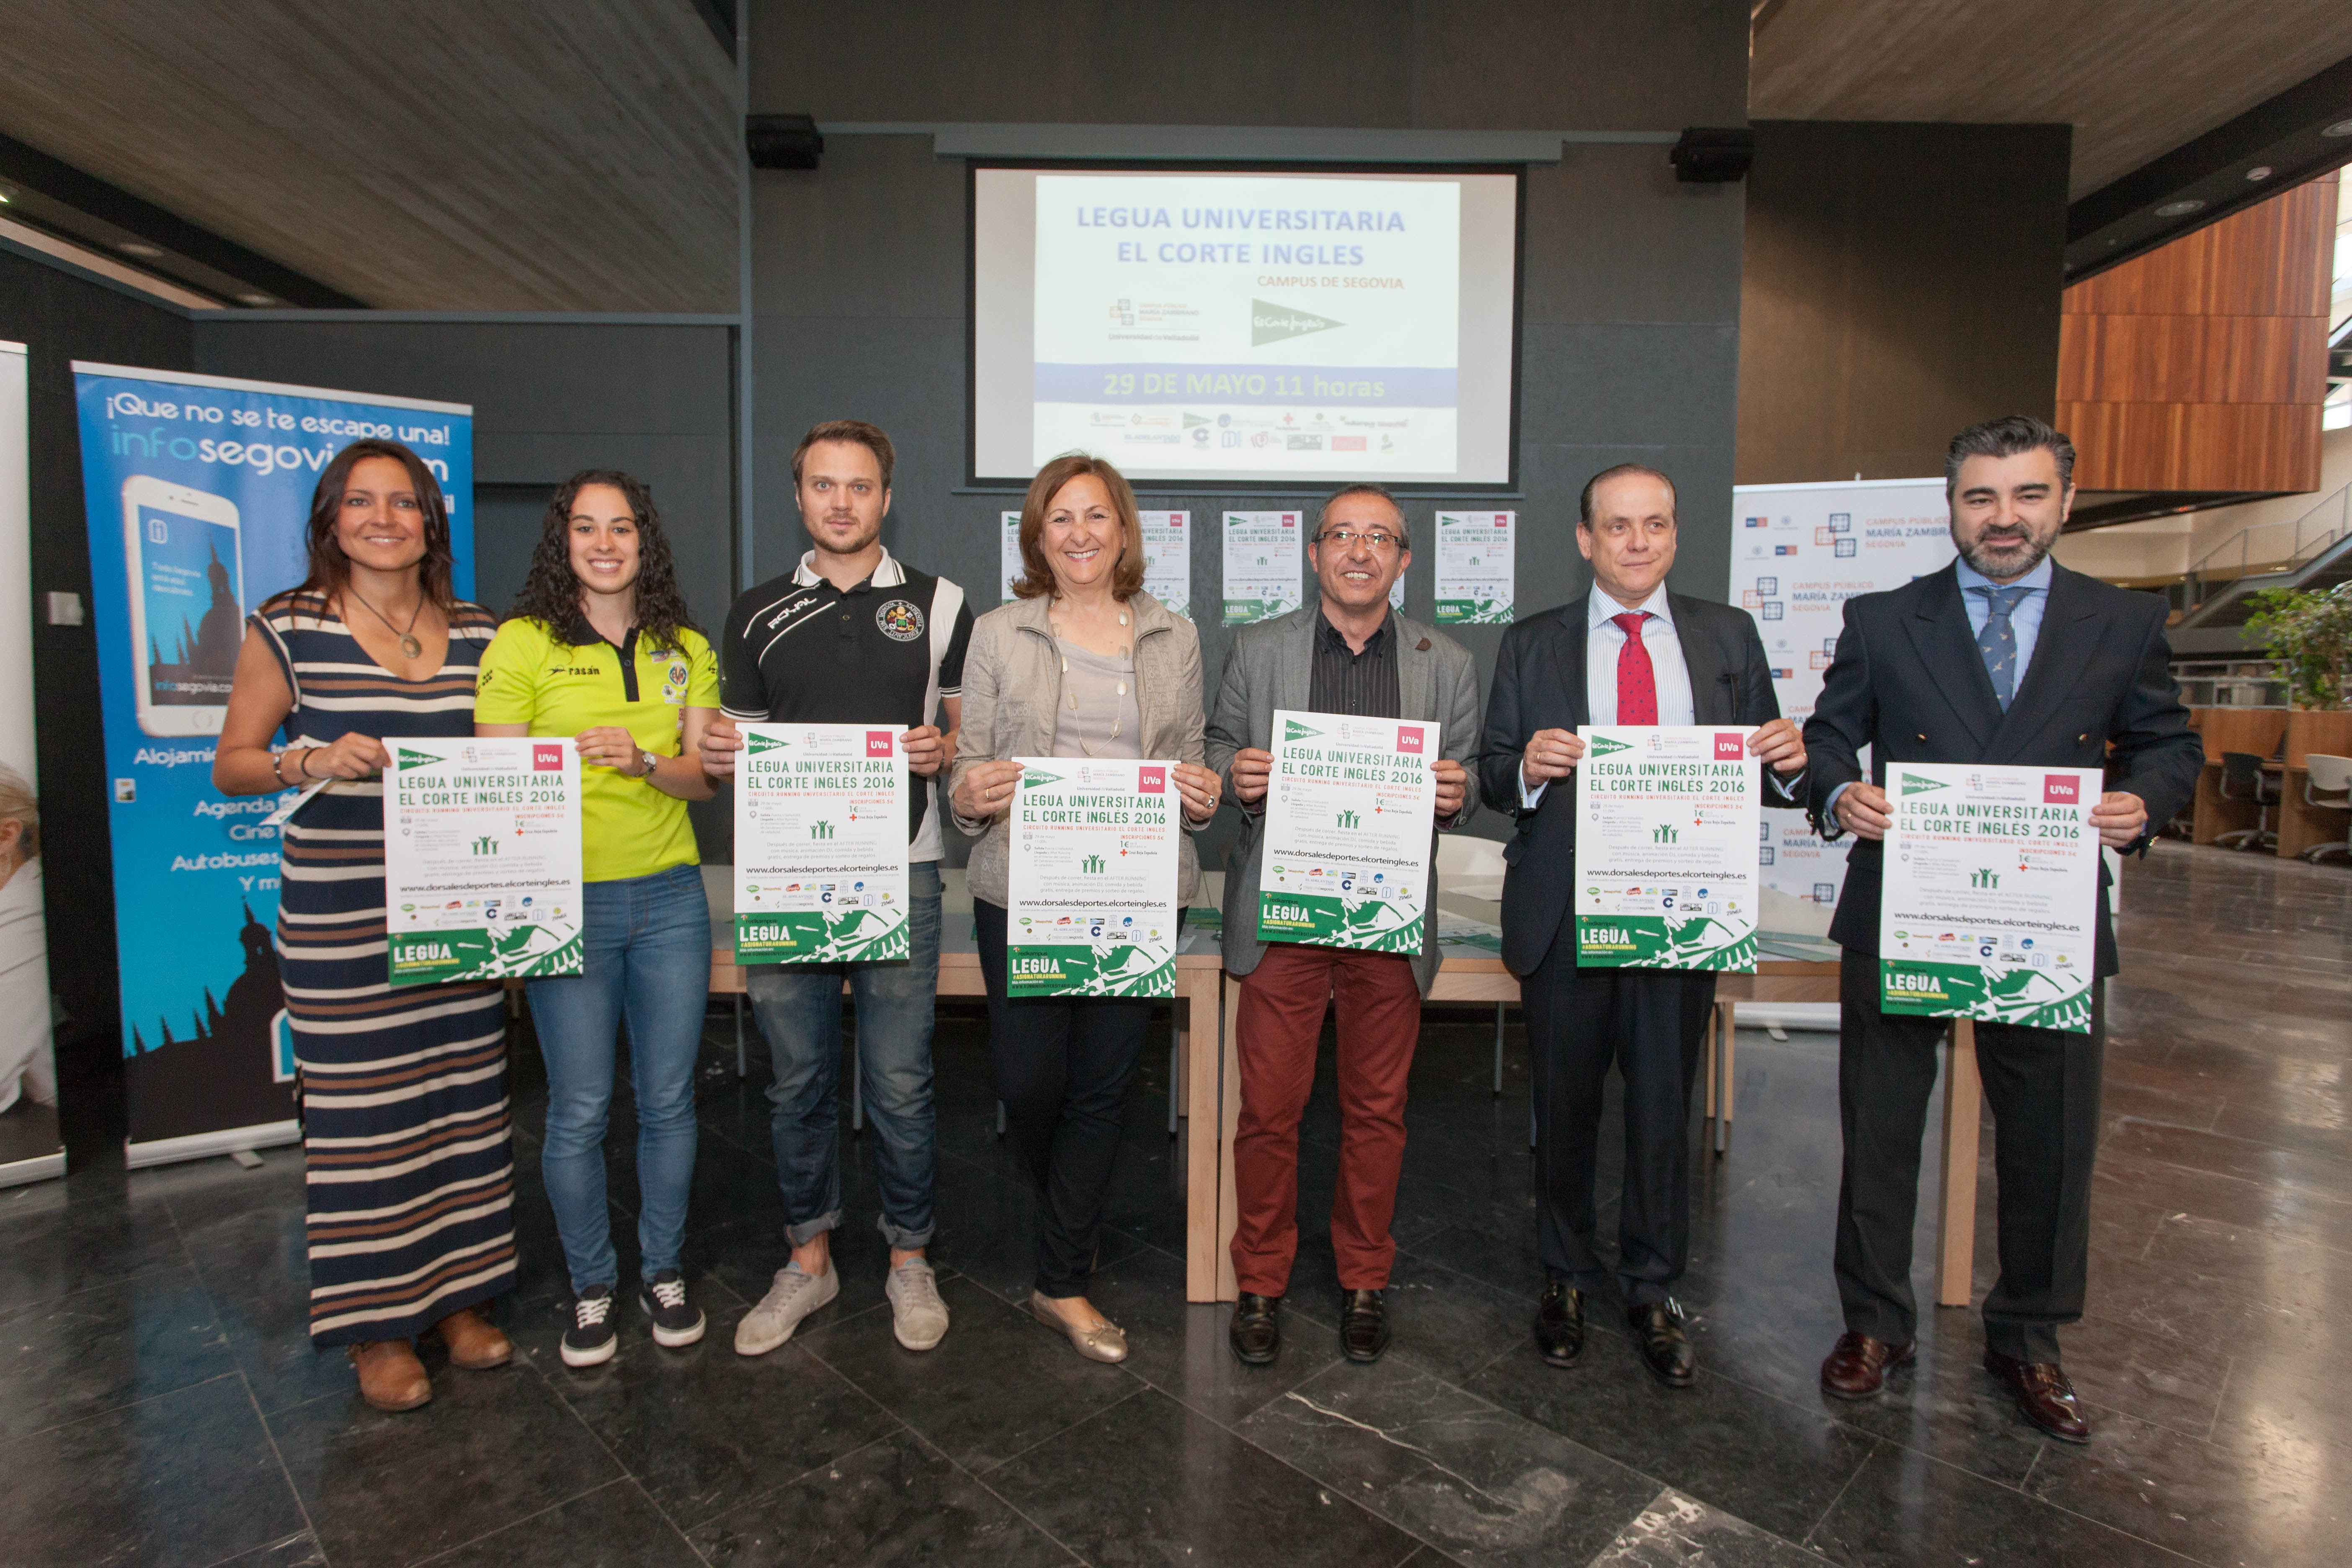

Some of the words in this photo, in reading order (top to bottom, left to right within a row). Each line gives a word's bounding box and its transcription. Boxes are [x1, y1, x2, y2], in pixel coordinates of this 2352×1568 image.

[1078, 207, 1171, 228] LEGUA
[1183, 208, 1406, 232] UNIVERSITARIA
[1118, 242, 1148, 262] EL
[1158, 243, 1251, 263] CORTE
[1263, 245, 1364, 266] INGLES
[1258, 276, 1317, 287] CAMPUS
[1321, 277, 1338, 287] DE
[1343, 277, 1404, 289] SEGOVIA
[1104, 373, 1134, 395] 29
[1144, 374, 1177, 394] DE
[1186, 374, 1266, 395] MAYO
[1275, 375, 1304, 395] 11
[1314, 376, 1385, 397] horas
[107, 393, 179, 420] ¡Que
[185, 403, 223, 423] no
[232, 408, 261, 427] se
[266, 407, 295, 431] te
[301, 415, 393, 439] escape
[398, 425, 450, 446] una!
[1792, 591, 1827, 601] MARÍA
[568, 665, 600, 675] rasán
[1402, 736, 1420, 745] UVa
[1719, 743, 1739, 751] UVa
[1283, 747, 1322, 761] LEGUA
[1328, 750, 1423, 769] UNIVERSITARIA
[748, 761, 789, 772] LEGUA
[795, 761, 894, 773] UNIVERSITARIA
[1282, 762, 1295, 774] EL
[1300, 763, 1338, 778] CORTE
[1344, 765, 1385, 781] INGLÉS
[1391, 771, 1423, 784] 2016
[1590, 763, 1632, 775] LEGUA
[1639, 764, 1743, 776] UNIVERSITARIA
[398, 776, 446, 789] LEGUA
[453, 775, 564, 788] UNIVERSITARIA
[748, 777, 762, 788] EL
[768, 777, 808, 788] CORTE
[814, 774, 857, 788] INGLÉS
[863, 777, 895, 788] 2016
[1590, 779, 1604, 791] EL
[1610, 780, 1652, 791] CORTE
[1658, 777, 1703, 792] INGLÉS
[1710, 781, 1744, 792] 2016
[399, 793, 416, 805] EL
[422, 792, 468, 805] CORTE
[474, 789, 523, 804] INGLÉS
[529, 791, 565, 802] 2016
[2050, 785, 2073, 794] UVa
[193, 797, 276, 820] Agenda
[1023, 794, 1063, 807] LEGUA
[1069, 795, 1165, 808] UNIVERSITARIA
[1023, 810, 1037, 822] EL
[1042, 811, 1081, 823] CORTE
[1087, 809, 1128, 823] INGLÉS
[1134, 812, 1166, 824] 2016
[1901, 802, 1949, 816] LEGUA
[1956, 804, 2079, 821] UNIVERSITARIA
[229, 824, 276, 841] Cine
[1900, 818, 1916, 831] EL
[1923, 819, 1970, 833] CORTE
[1977, 819, 2030, 836] INGLÉS
[2038, 824, 2079, 838] 2016
[170, 852, 280, 872] Autobuses
[1274, 849, 1418, 867] www.dorsalesdeportes.elcorteingles.es
[746, 864, 898, 875] www.dorsalesdeportes.elcorteingles.es
[1587, 869, 1746, 880] www.dorsalesdeportes.elcorteingles.es
[400, 878, 570, 893] www.dorsalesdeportes.elcorteingles.es
[1019, 899, 1166, 909] www.dorsalesdeportes.elcorteingles.es
[1263, 904, 1310, 923] LEGUA
[1894, 912, 2079, 931] www.dorsalesdeportes.elcorteingles.es
[740, 926, 790, 942] LEGUA
[1580, 928, 1630, 944] LEGUA
[394, 944, 451, 962] LEGUA
[1012, 958, 1060, 973] LEGUA
[1884, 972, 1941, 993] LEGUA
